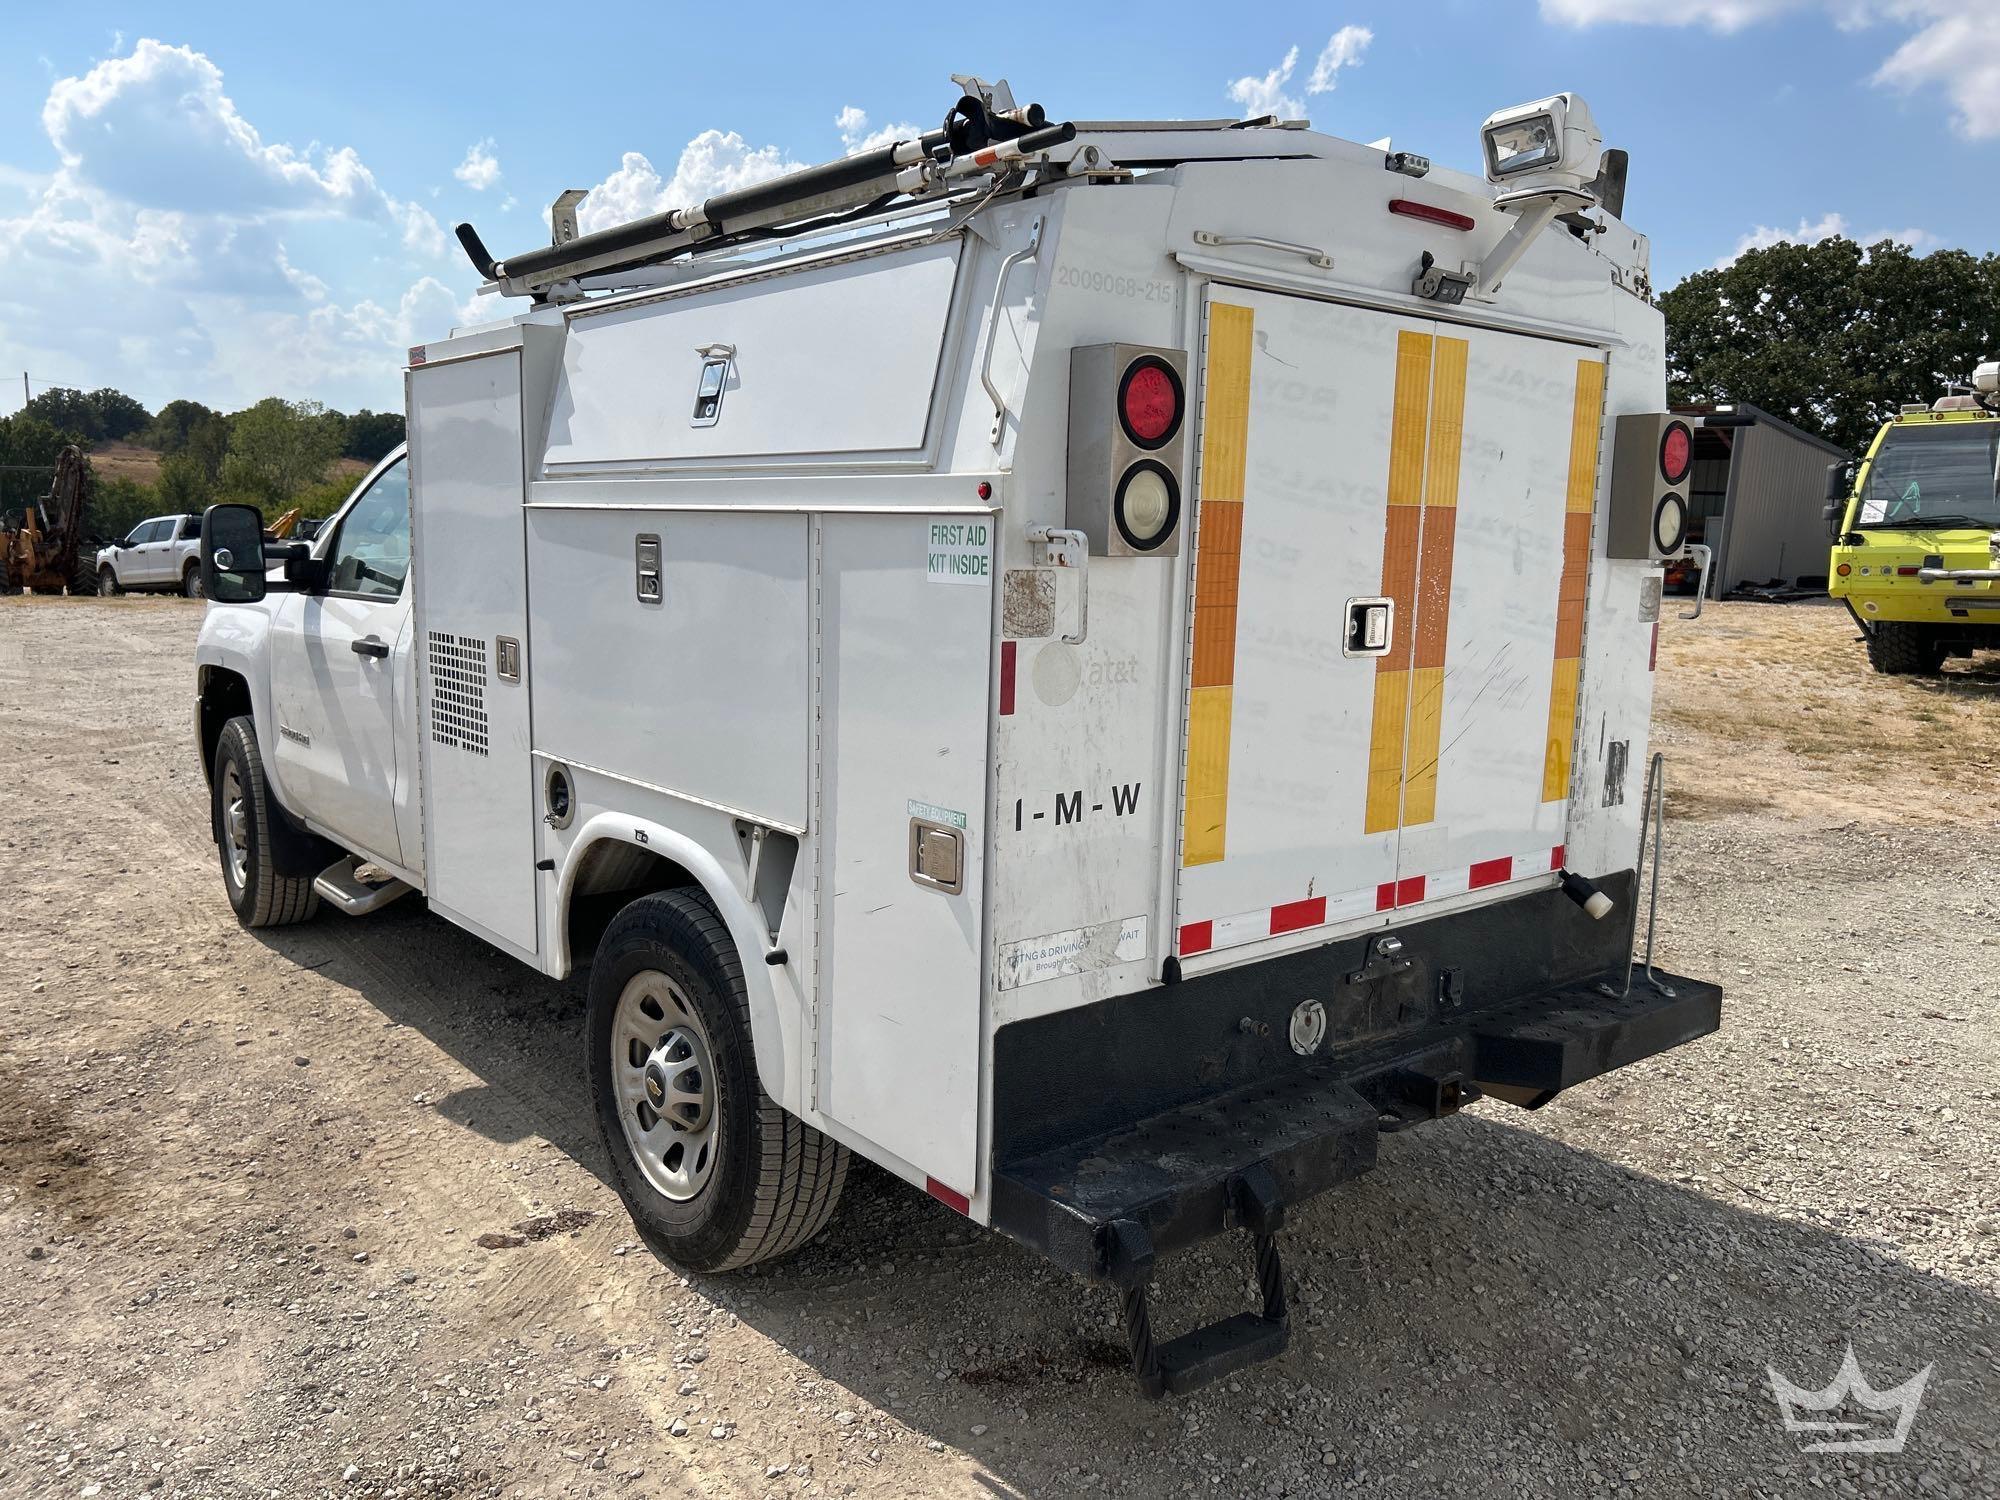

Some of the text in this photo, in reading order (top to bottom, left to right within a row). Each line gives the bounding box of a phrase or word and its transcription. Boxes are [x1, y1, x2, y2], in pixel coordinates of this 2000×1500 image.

[1058, 265, 1171, 303] 2009068-215
[931, 525, 987, 546] FIRST AID
[928, 553, 988, 576] KIT INSIDE
[1088, 654, 1138, 687] at&t
[1040, 949, 1047, 959] &
[1048, 941, 1085, 957] DRIVING
